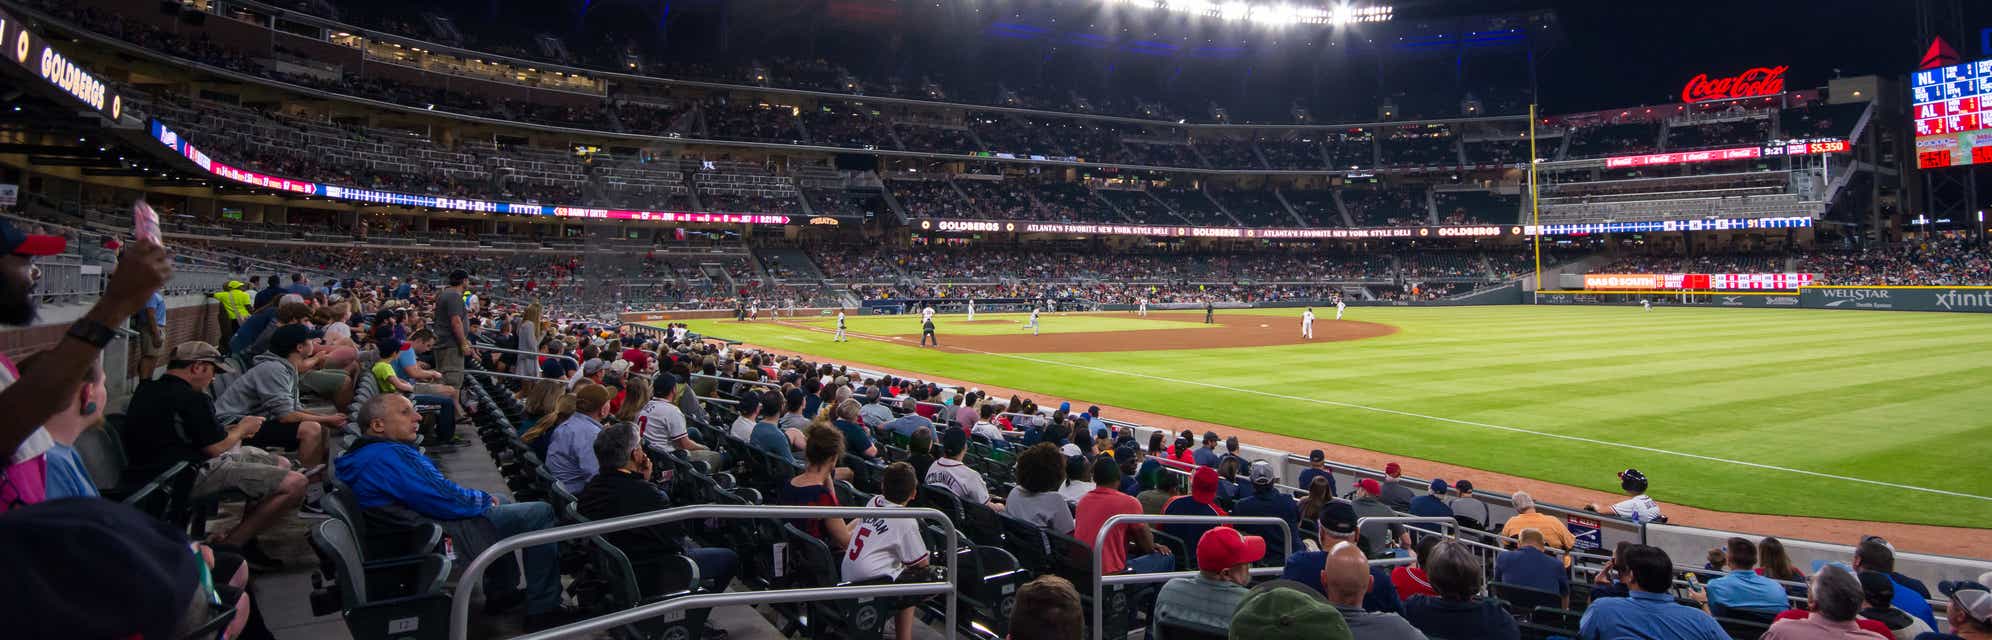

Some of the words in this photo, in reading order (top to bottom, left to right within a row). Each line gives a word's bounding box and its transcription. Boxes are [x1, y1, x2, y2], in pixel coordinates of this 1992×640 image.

[41, 47, 105, 110] GOLDBERGS
[1682, 65, 1789, 103] Coca-Cola
[1918, 72, 1935, 85] NL
[1922, 104, 1938, 118] AL
[1764, 147, 1784, 155] 9:21
[1811, 142, 1844, 153] $5,350
[939, 221, 999, 231] GOLDBERGS
[1027, 224, 1063, 232] ATLANTA'S
[1065, 225, 1096, 233] FAVORITE
[1098, 225, 1112, 233] NEW
[1114, 226, 1131, 234] YORK
[1133, 226, 1151, 235] STYLE
[1438, 227, 1501, 236] GOLDBERGS
[1193, 228, 1240, 237] GOLDBERGS
[1300, 229, 1331, 237] FAVORITE
[1333, 229, 1347, 237] NEW
[1349, 229, 1368, 237] YORK
[1370, 229, 1392, 237] STYLE
[1394, 229, 1411, 237] DELI
[1620, 277, 1654, 286] SOUTH
[1822, 289, 1889, 300] WELLSTAR
[849, 526, 872, 561] 5
